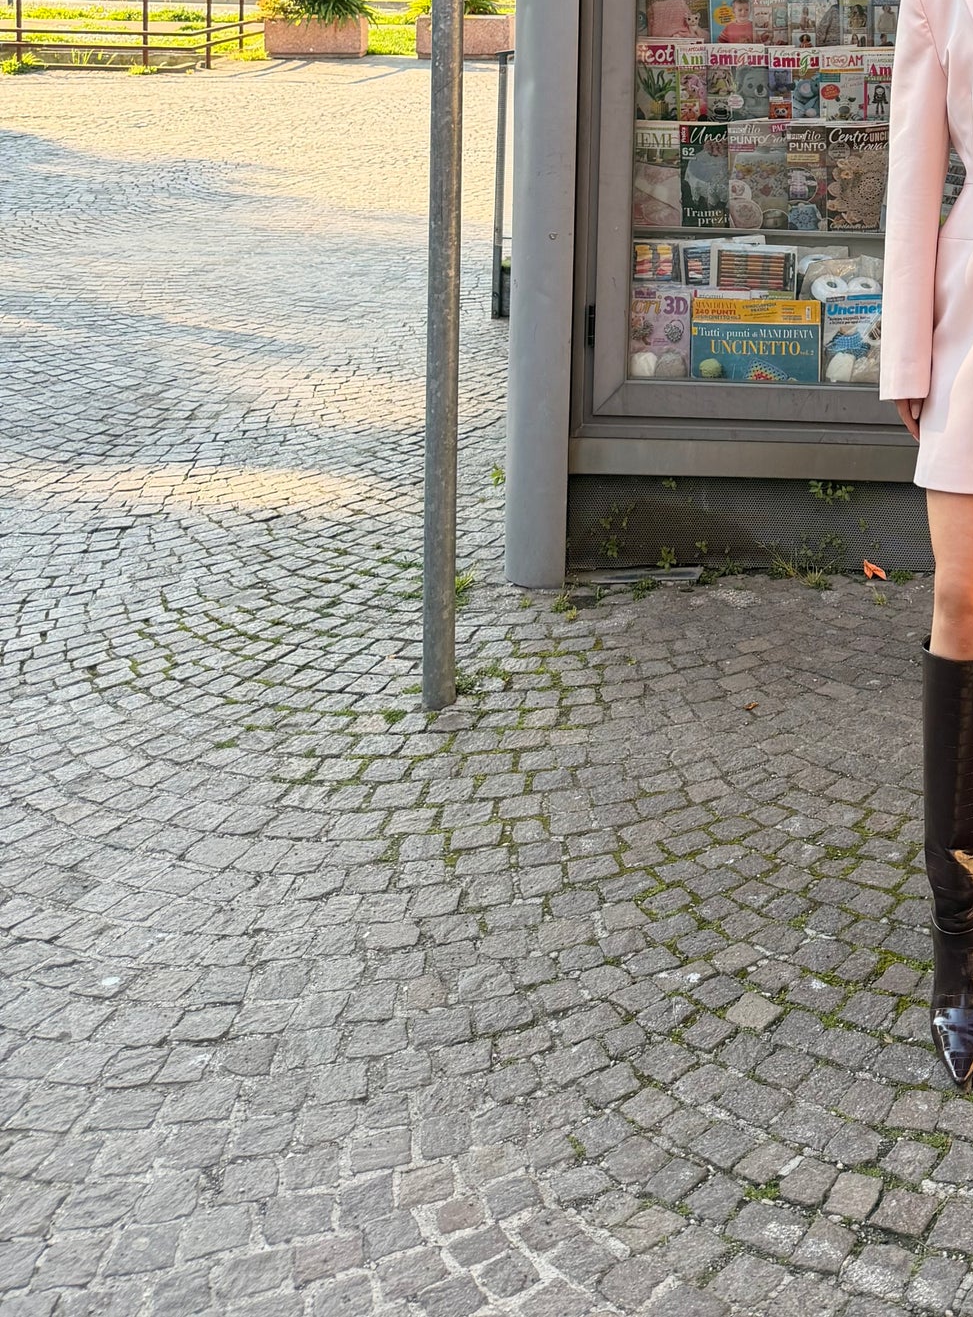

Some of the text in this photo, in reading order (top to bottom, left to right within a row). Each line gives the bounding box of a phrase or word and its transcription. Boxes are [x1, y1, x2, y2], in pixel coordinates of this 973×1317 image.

[682, 147, 695, 156] 62
[788, 142, 827, 151] PUNTO
[684, 207, 722, 217] Trame
[663, 295, 689, 316] 3D
[698, 326, 720, 337] Tutti
[726, 328, 750, 340] punti
[710, 339, 800, 356] UNCINETTO
